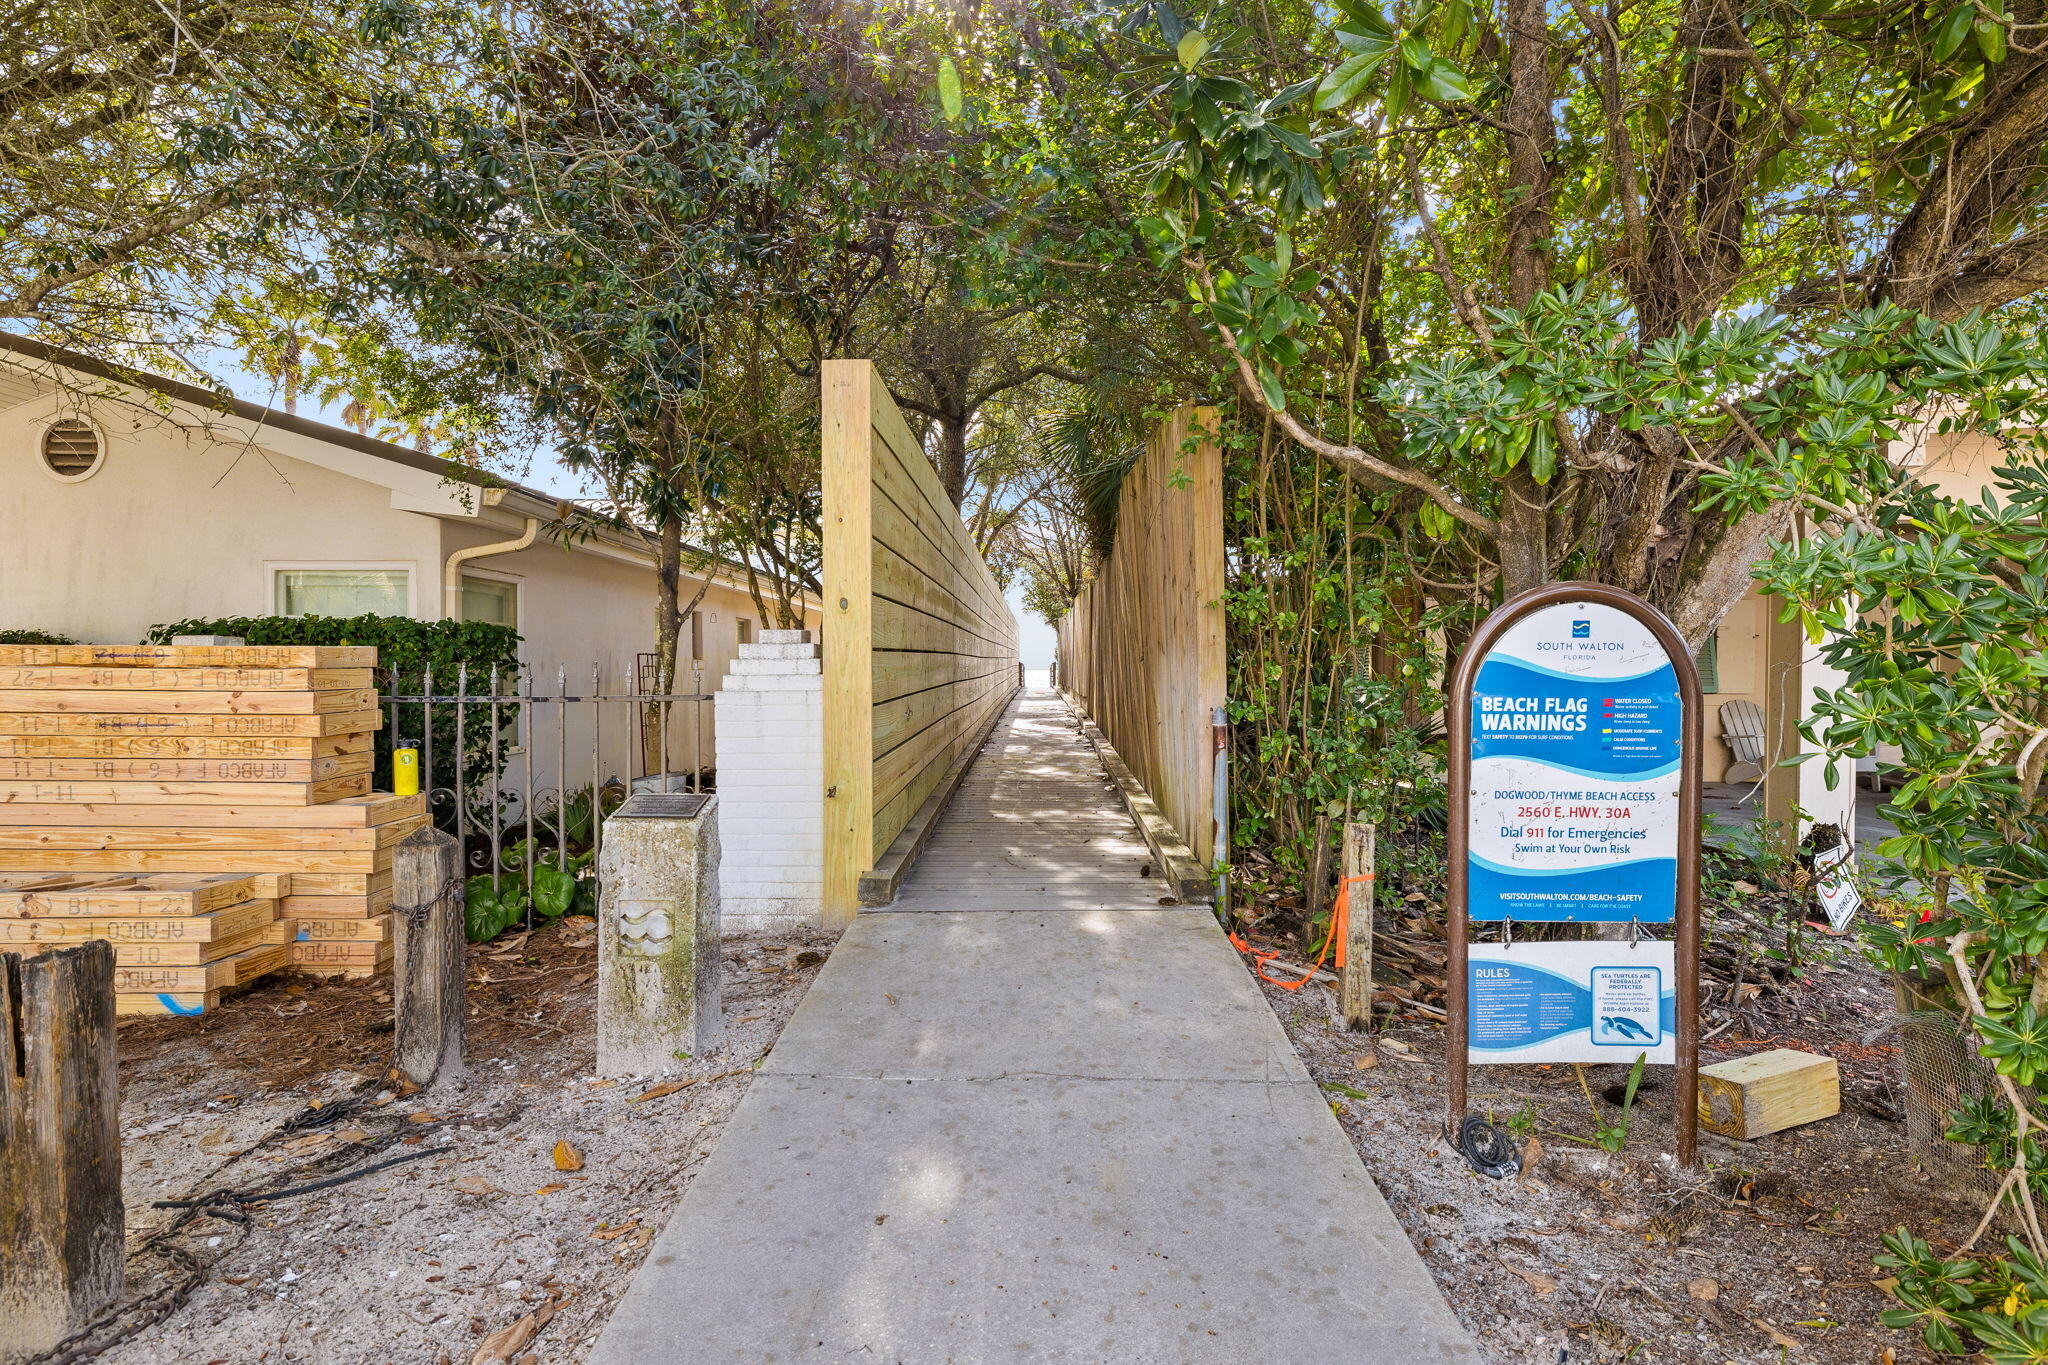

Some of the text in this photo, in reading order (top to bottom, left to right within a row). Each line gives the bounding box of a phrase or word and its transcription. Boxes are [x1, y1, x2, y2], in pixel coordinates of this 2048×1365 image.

[1536, 642, 1624, 651] SOUTH WALTON
[223, 648, 292, 664] AFABCO
[216, 671, 284, 688] AFABCO
[1482, 697, 1588, 712] BEACH FLAG
[1481, 714, 1587, 732] WARNINGS
[218, 740, 288, 756] AFABCO
[218, 762, 286, 779] AFABCO
[1494, 790, 1656, 801] DOGWOOD/THYME BEACH ACCESS
[1517, 806, 1631, 818] 2560 E. HWY. 30A
[1501, 826, 1646, 842] Dial 911 for Emergencies
[1515, 843, 1631, 854] Swim at Your Own Risk
[1500, 892, 1643, 901] VISITSOUTHWALTON.COM/BEACH-SAFETY
[69, 898, 92, 915] B1
[135, 897, 186, 914] T-22
[1834, 891, 1853, 920] NO BIKES
[107, 922, 184, 939] AFABCO
[1476, 968, 1510, 978] RULES
